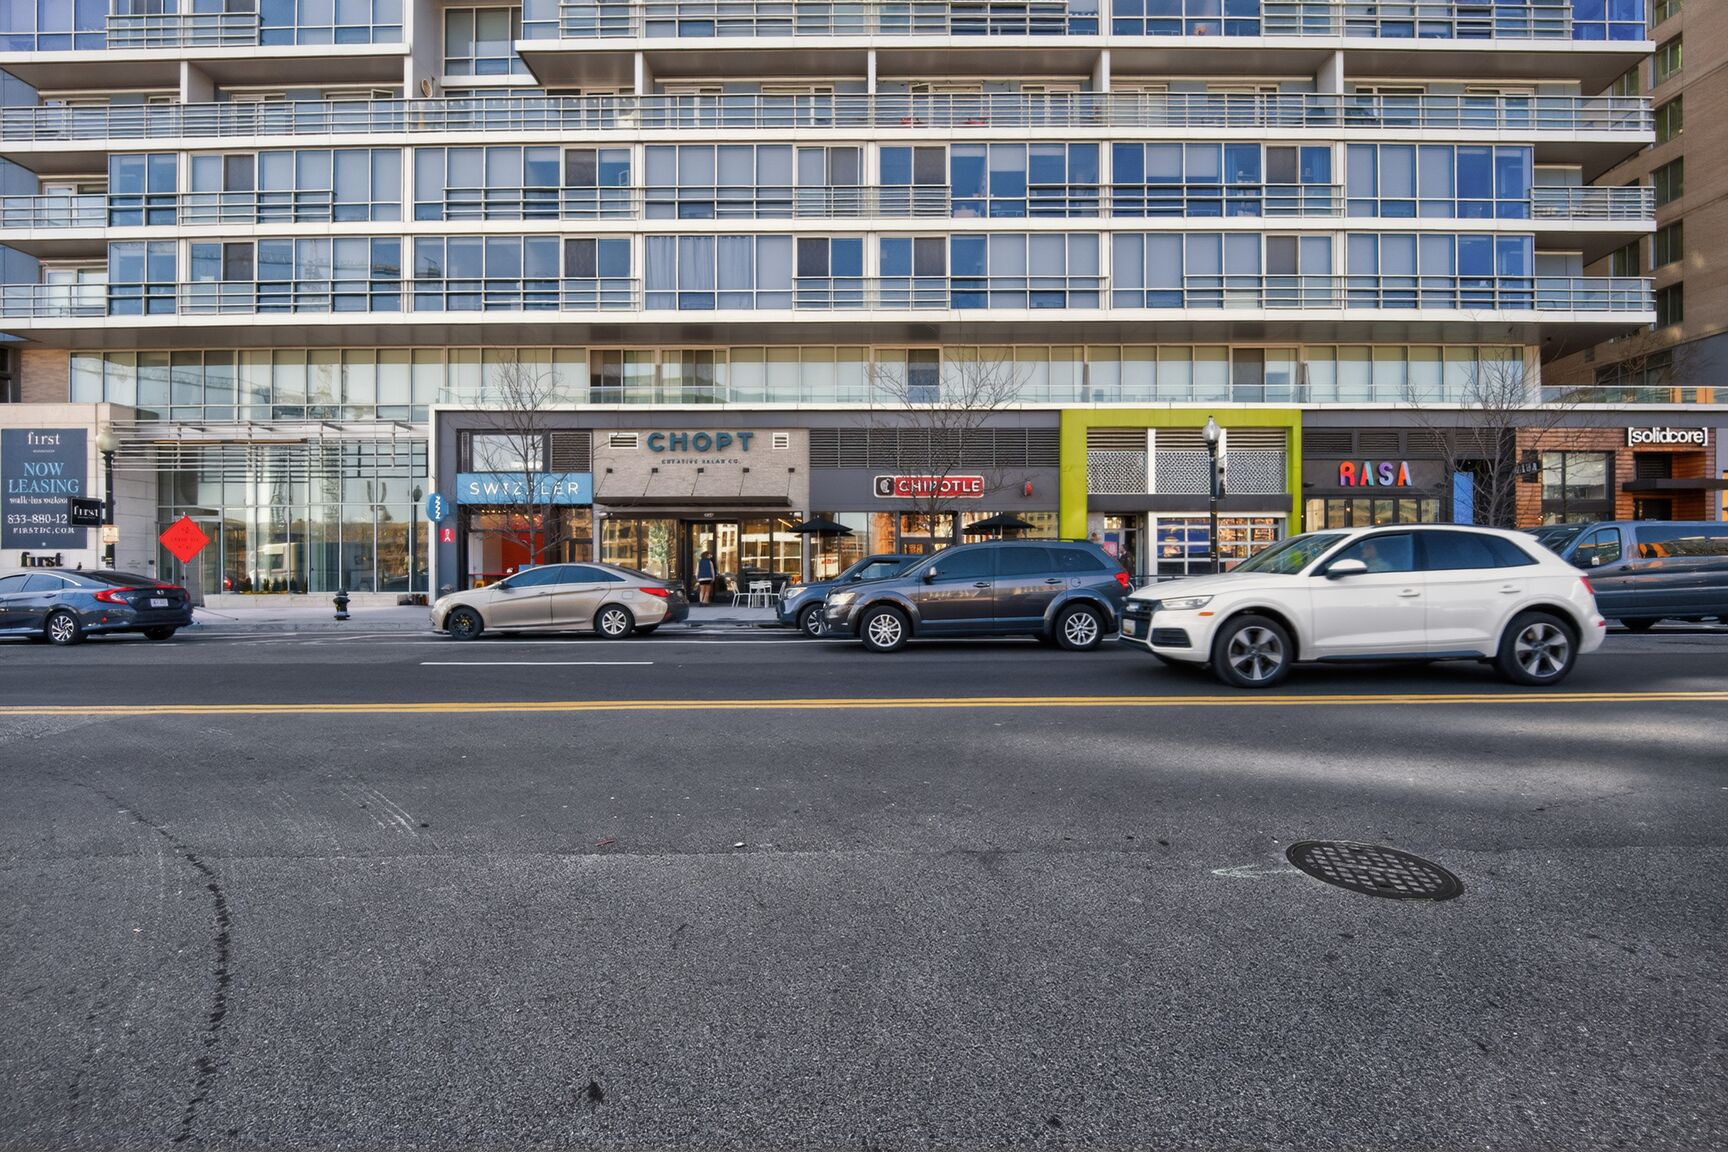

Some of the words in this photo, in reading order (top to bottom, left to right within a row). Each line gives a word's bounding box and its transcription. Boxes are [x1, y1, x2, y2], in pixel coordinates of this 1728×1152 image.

[27, 431, 60, 445] first
[647, 431, 754, 453] CHOPT
[23, 462, 64, 477] NOW
[1340, 461, 1413, 487] RASA
[8, 478, 80, 494] LEASING
[898, 480, 981, 492] CHIPOTLE
[73, 505, 99, 517] first
[7, 513, 68, 524] 833-880-12
[13, 526, 75, 534] FIRSTDC.COM
[20, 551, 63, 568] first
